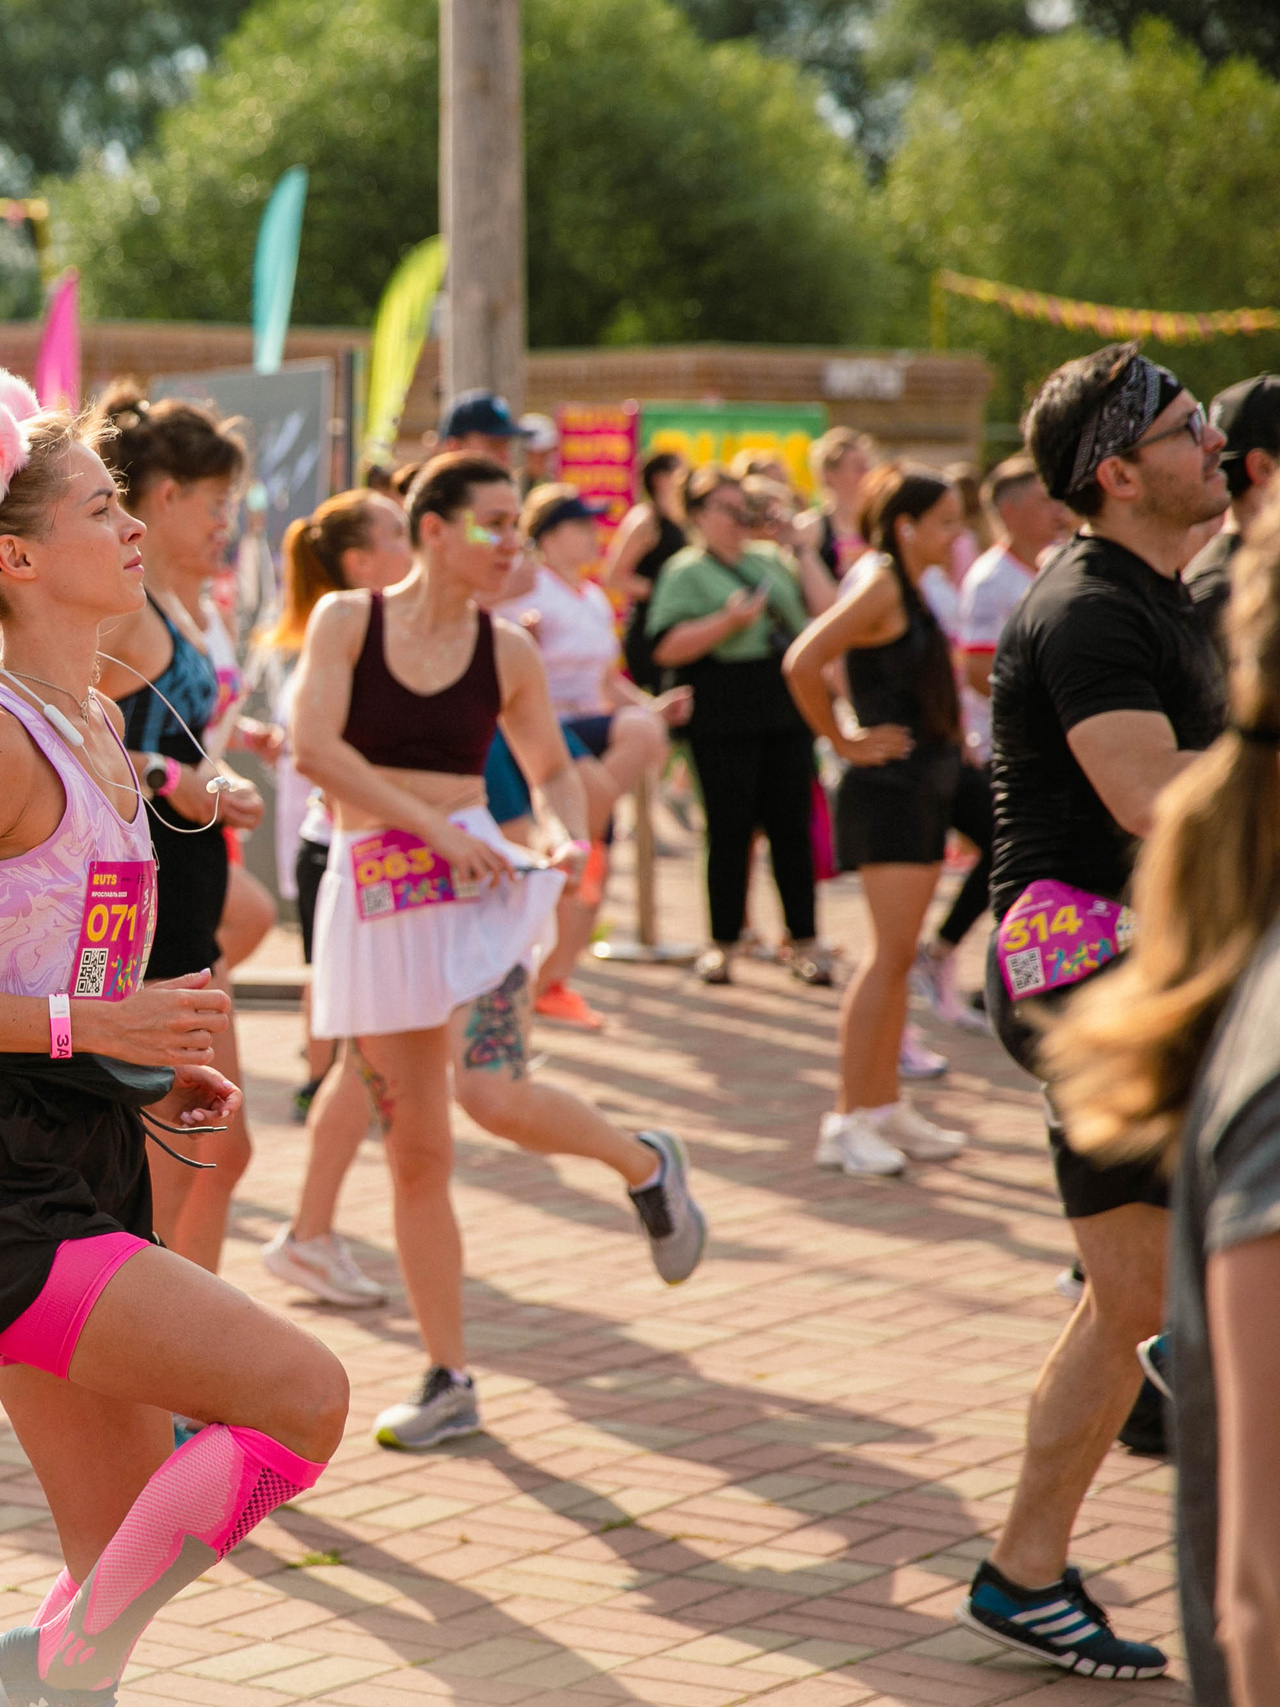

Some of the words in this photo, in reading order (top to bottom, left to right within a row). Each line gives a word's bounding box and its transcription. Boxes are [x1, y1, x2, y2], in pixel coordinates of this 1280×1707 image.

[93, 874, 118, 885] RUTS
[87, 904, 137, 942] 071
[1004, 905, 1083, 950] 314
